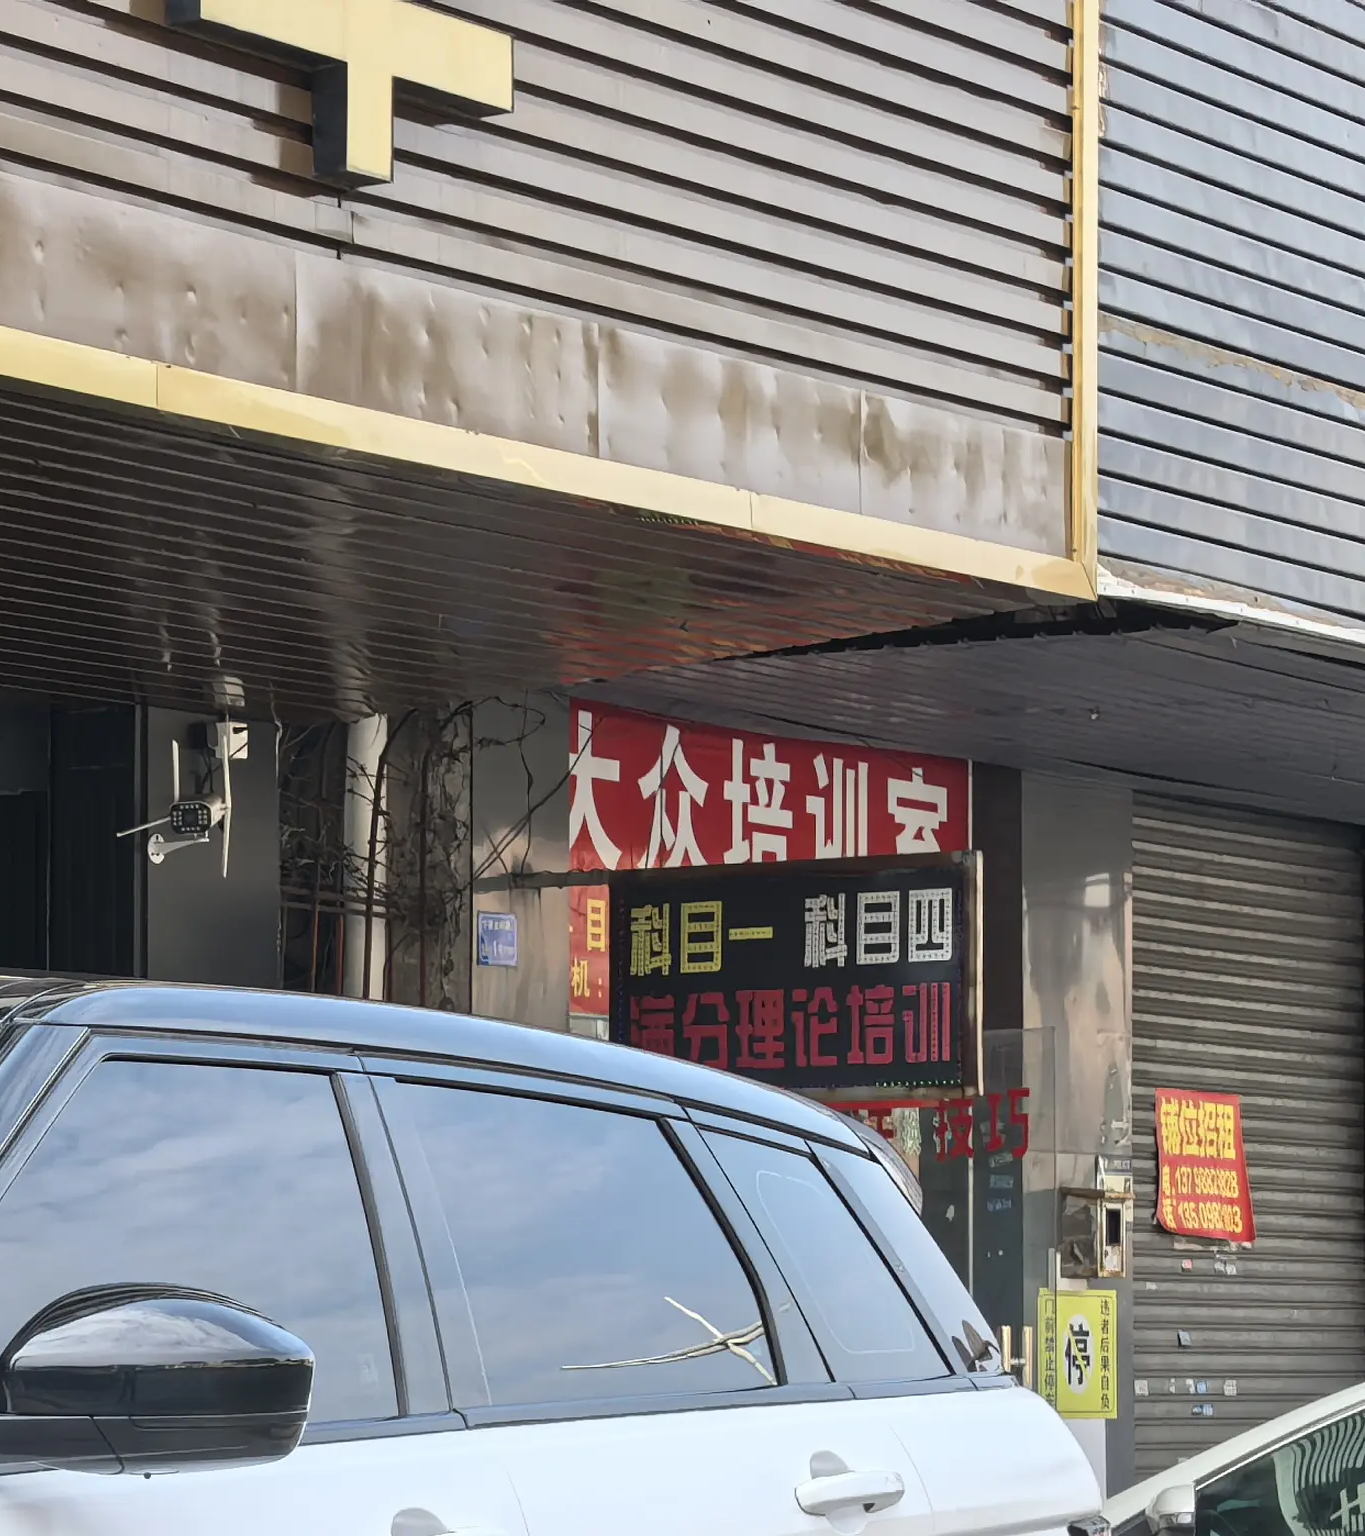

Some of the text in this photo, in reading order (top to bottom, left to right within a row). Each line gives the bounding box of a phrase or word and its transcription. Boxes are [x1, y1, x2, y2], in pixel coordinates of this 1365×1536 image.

[629, 887, 953, 976] 科目一 科目四
[629, 981, 951, 1069] 满分理论培训
